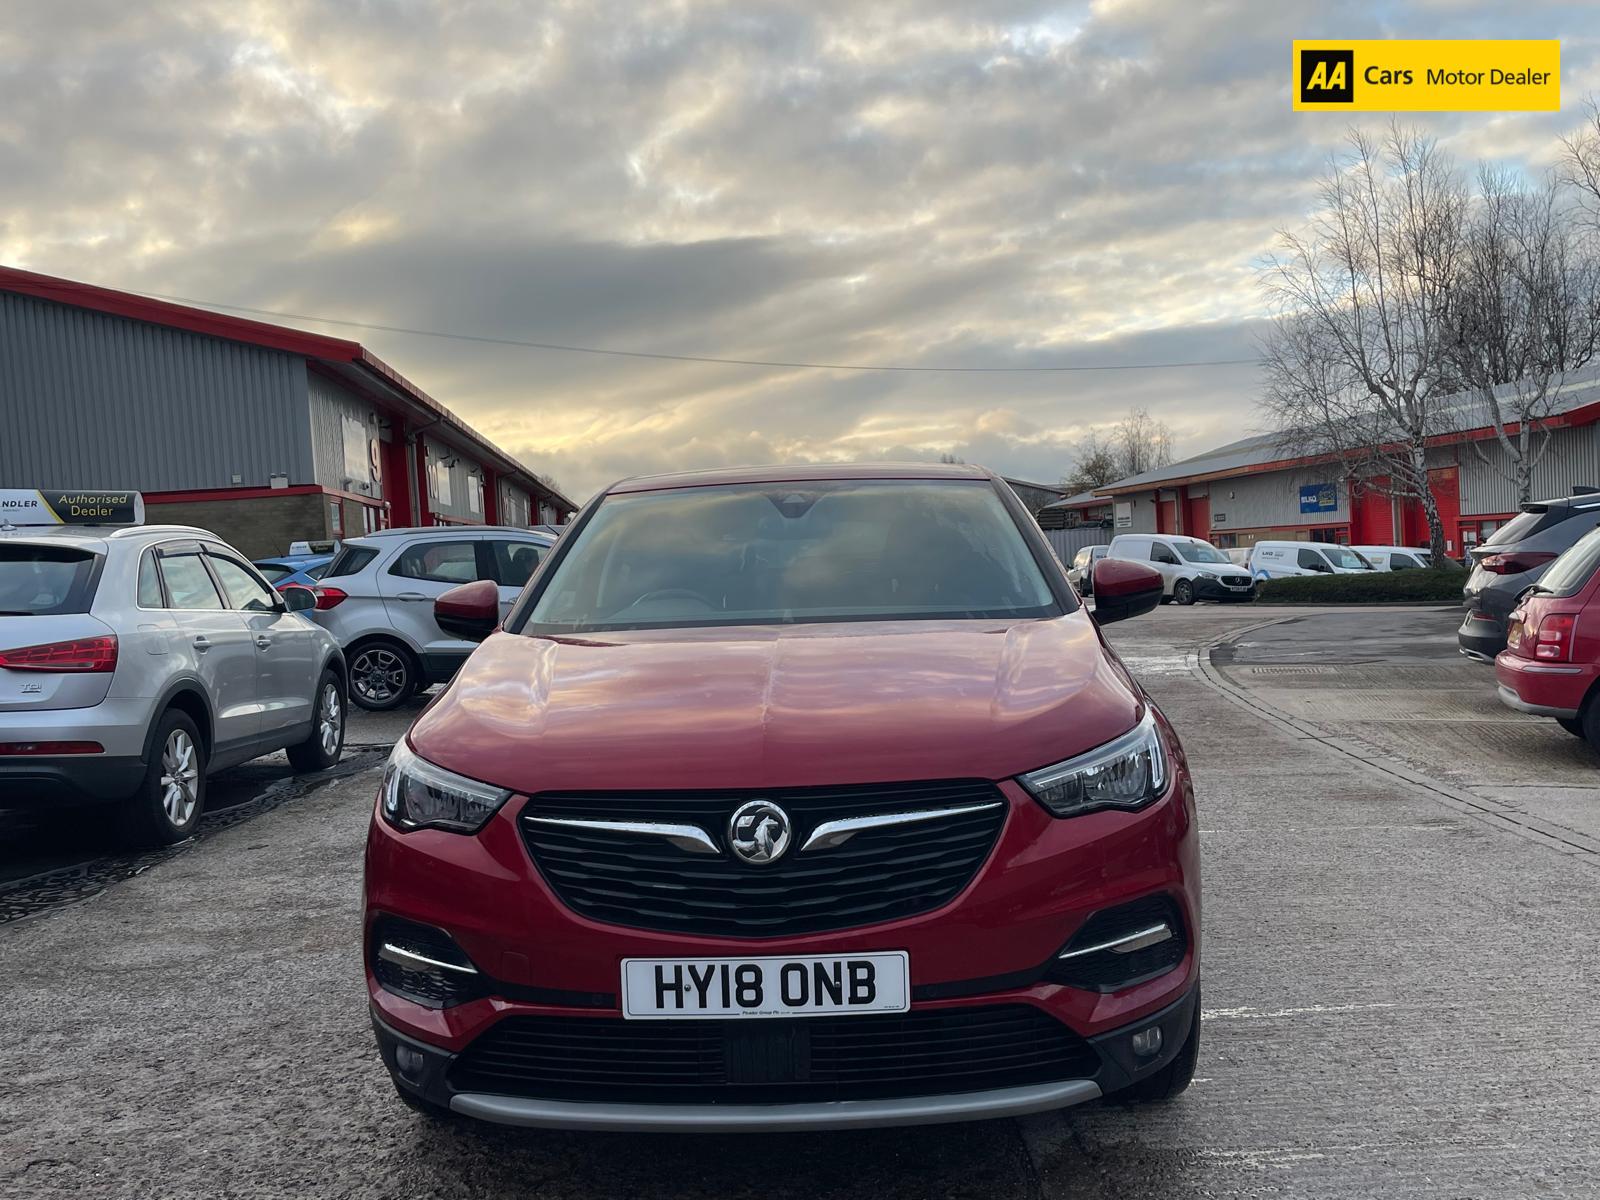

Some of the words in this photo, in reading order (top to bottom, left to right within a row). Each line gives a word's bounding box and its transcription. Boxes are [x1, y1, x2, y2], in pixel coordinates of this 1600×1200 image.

[369, 438, 382, 484] 9
[427, 464, 439, 499] 10
[2, 500, 38, 508] NDLER
[58, 493, 128, 504] Authorised
[71, 505, 113, 516] Dealer
[654, 963, 764, 1009] HY18
[780, 960, 877, 1007] ONB
